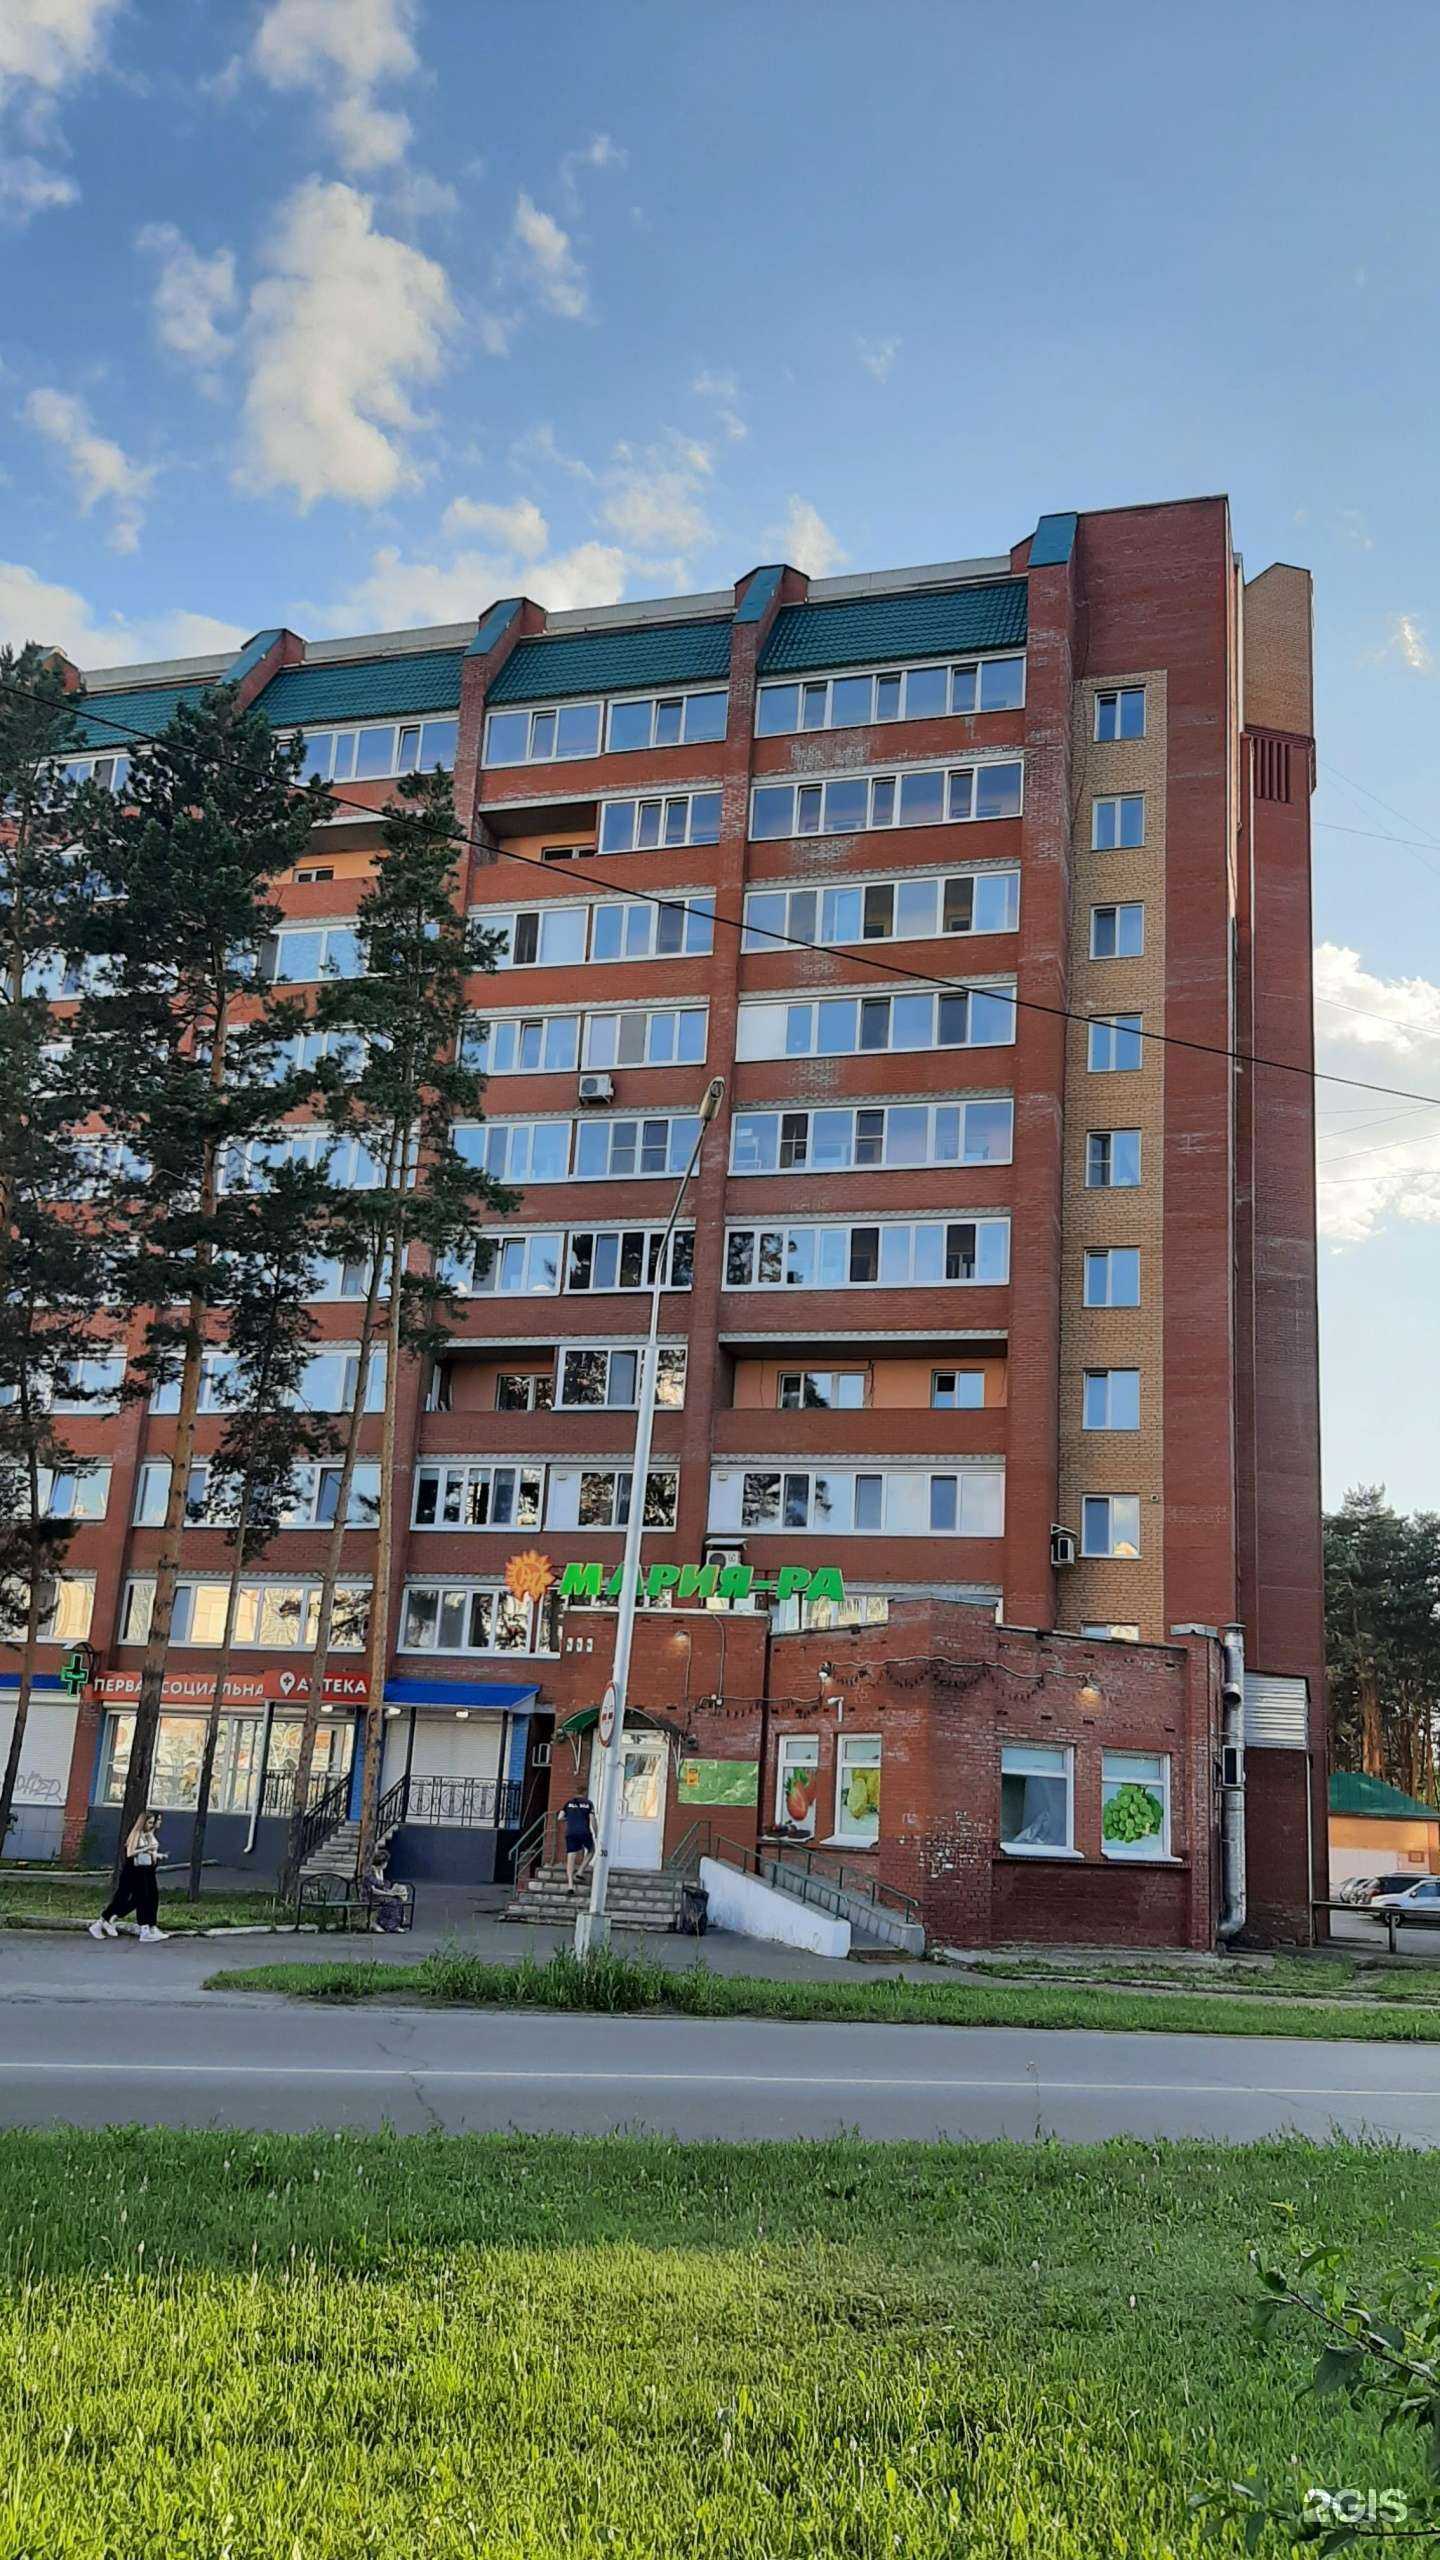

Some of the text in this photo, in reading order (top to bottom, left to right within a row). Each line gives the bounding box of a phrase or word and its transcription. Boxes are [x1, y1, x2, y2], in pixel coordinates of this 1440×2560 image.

[560, 1562, 845, 1601] МАРИЯ-РА
[94, 1678, 367, 1696] ПЕРВА СОЦИАЛЬНА АТЕКА
